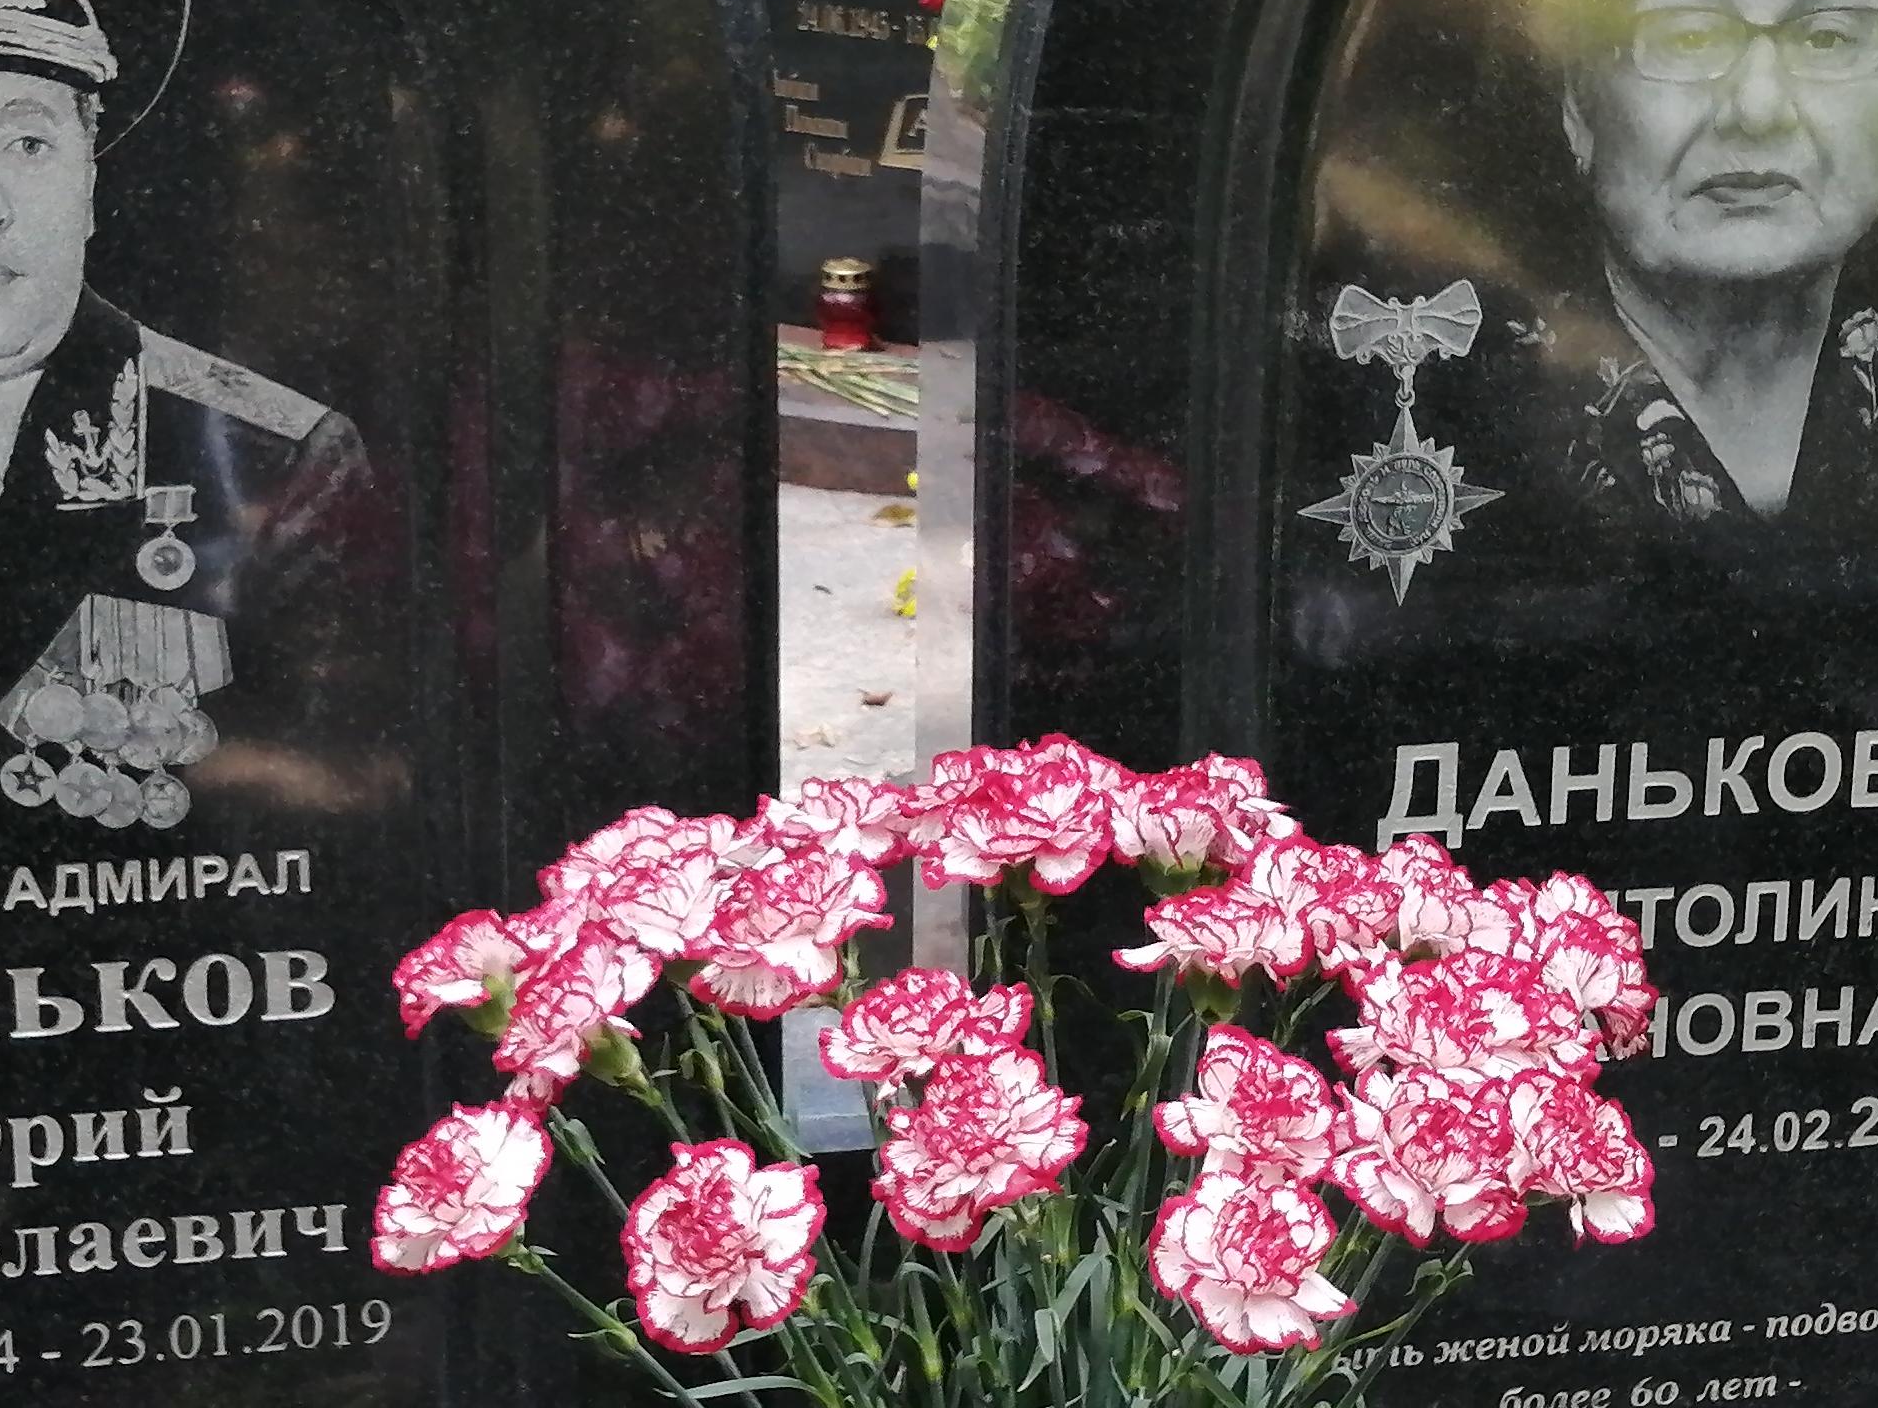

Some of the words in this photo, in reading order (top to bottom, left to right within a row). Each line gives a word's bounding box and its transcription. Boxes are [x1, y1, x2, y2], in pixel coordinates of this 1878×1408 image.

[2, 849, 312, 917] АДМИРАЛ
[81, 1298, 394, 1368] 23.01.2019
[1433, 1320, 1571, 1365] женой
[1577, 1319, 1733, 1358] моряка
[1629, 1376, 1681, 1408] 60
[1696, 1374, 1779, 1403] лет
